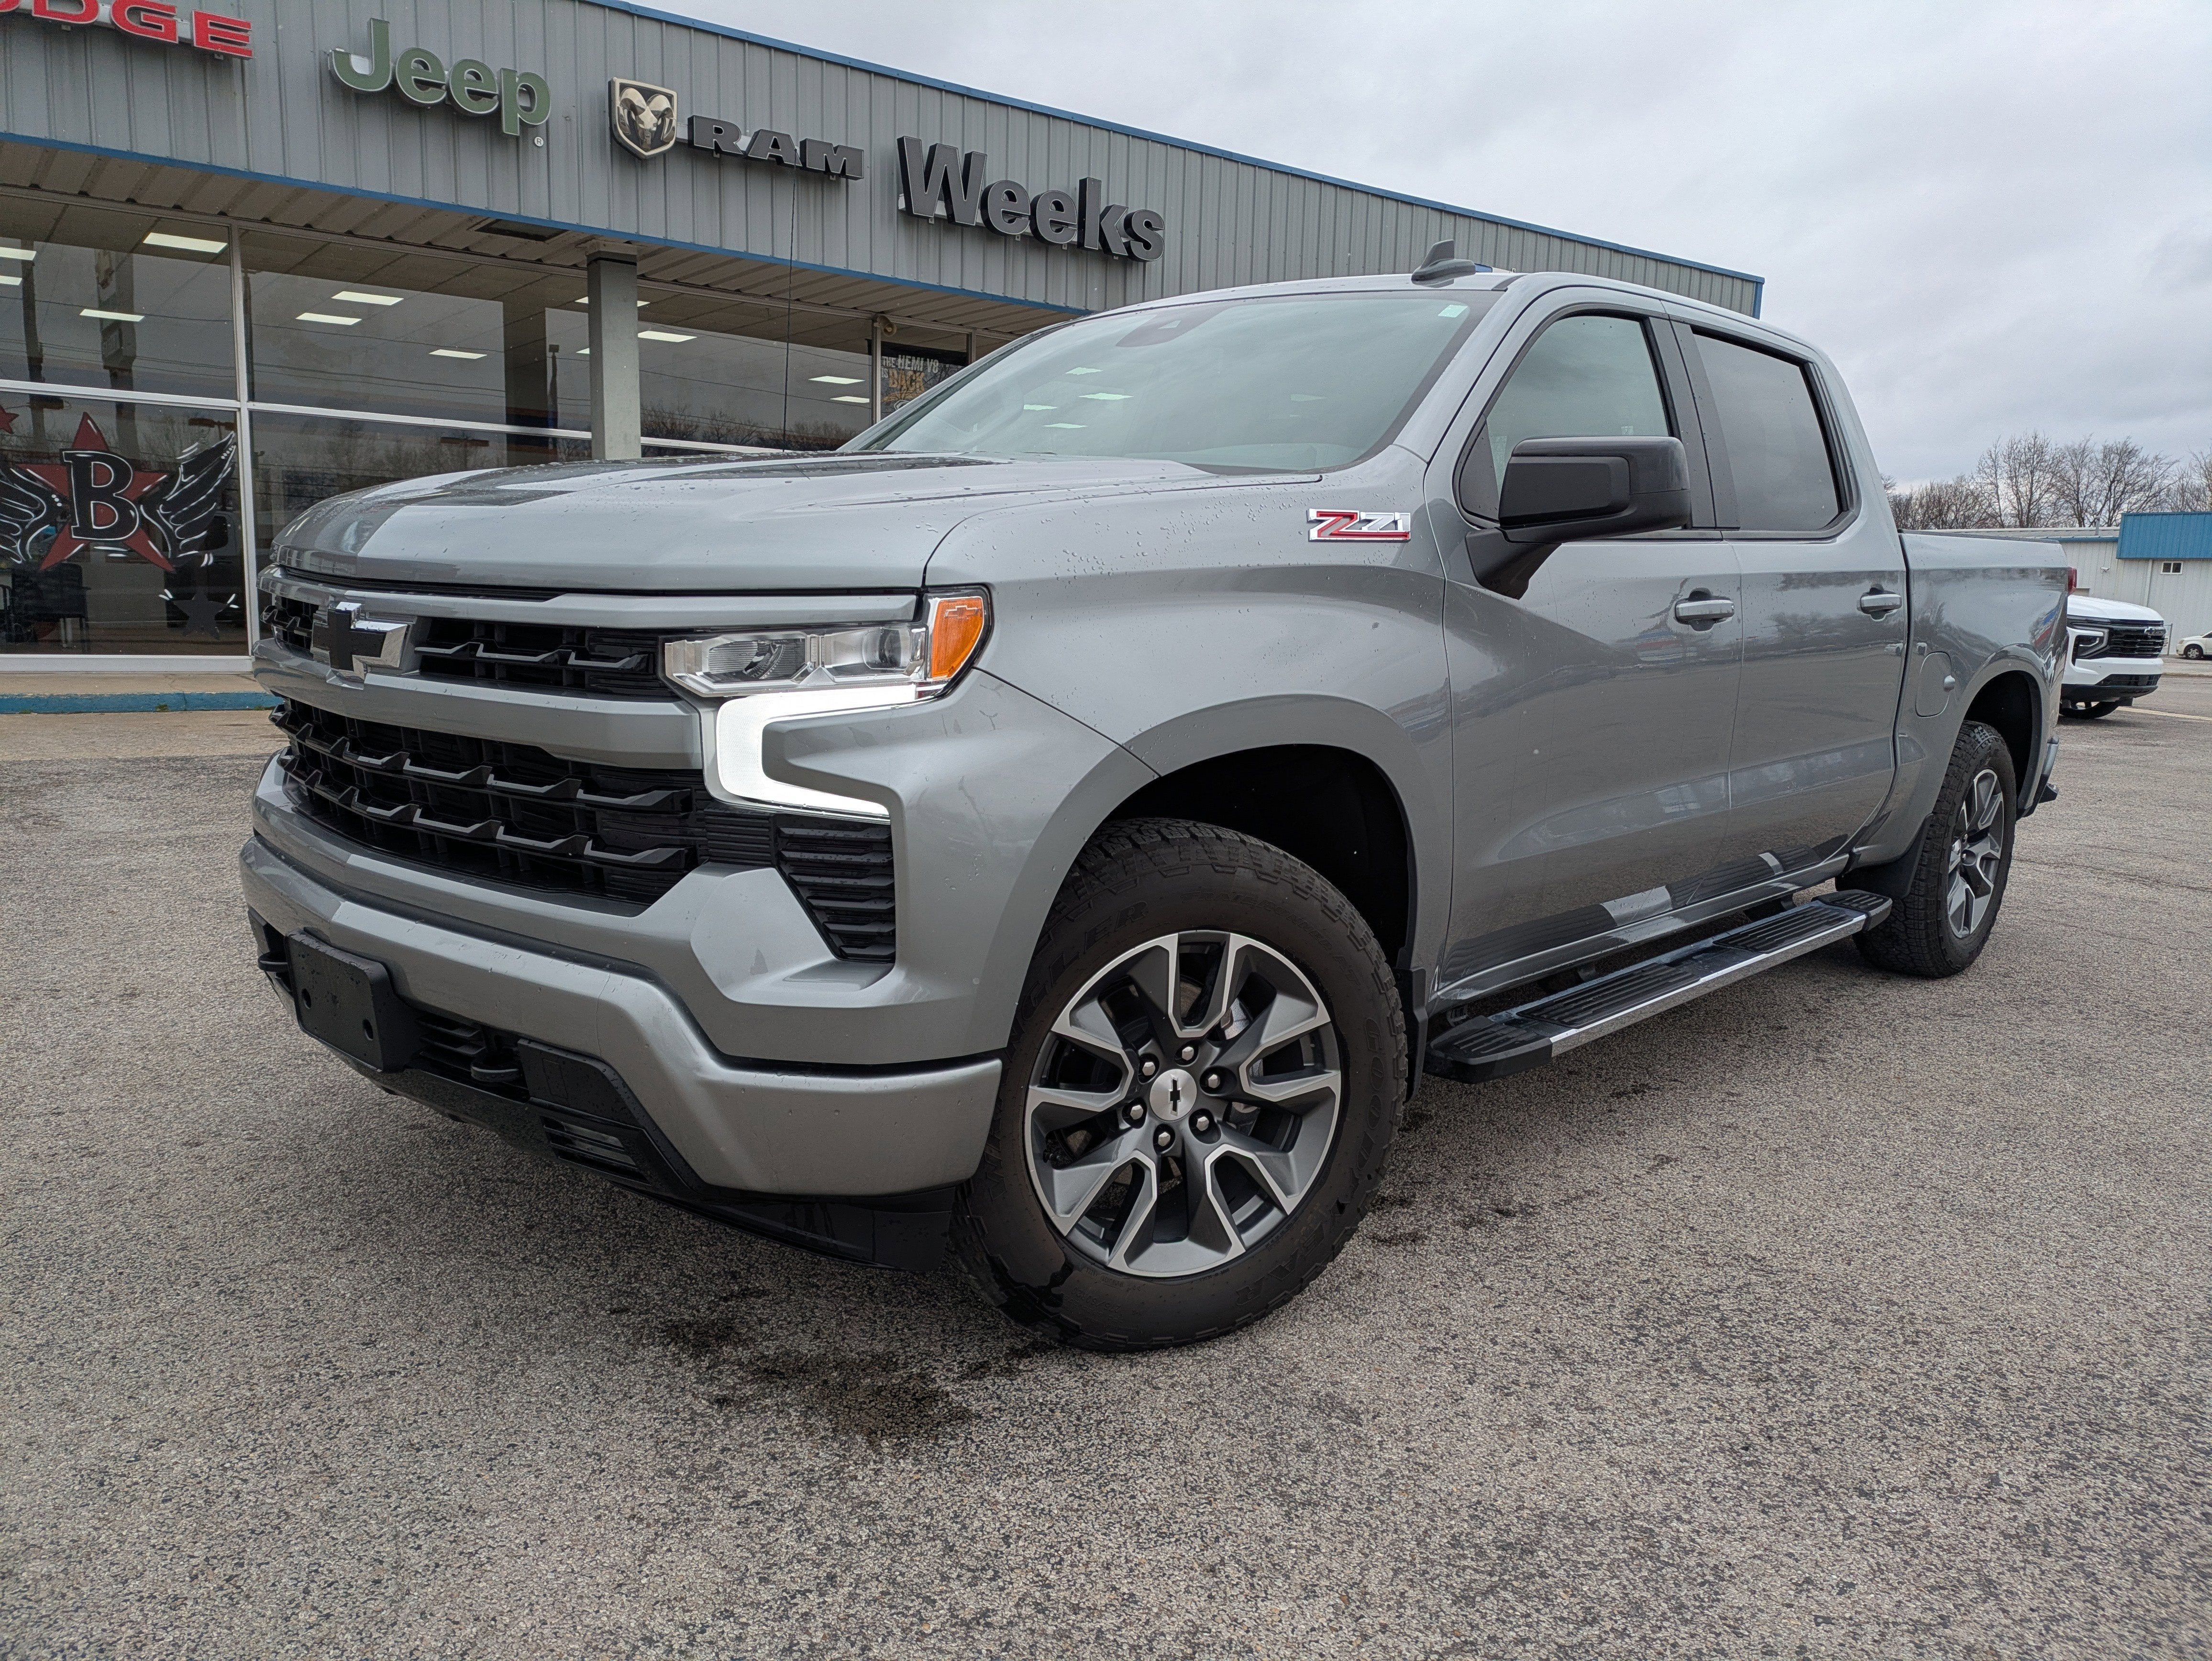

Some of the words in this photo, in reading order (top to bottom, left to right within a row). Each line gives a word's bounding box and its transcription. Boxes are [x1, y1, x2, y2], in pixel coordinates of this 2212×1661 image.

[0, 0, 254, 58] DGE
[328, 17, 551, 136] Jeep
[687, 114, 864, 180] RAM
[897, 135, 1165, 262] Weeks
[881, 355, 896, 368] THE
[897, 354, 924, 372] HEMI
[927, 358, 939, 374] V8
[881, 367, 889, 378] IS
[889, 368, 925, 393] BACK
[61, 448, 140, 541] B
[1307, 508, 1411, 543] Z71
